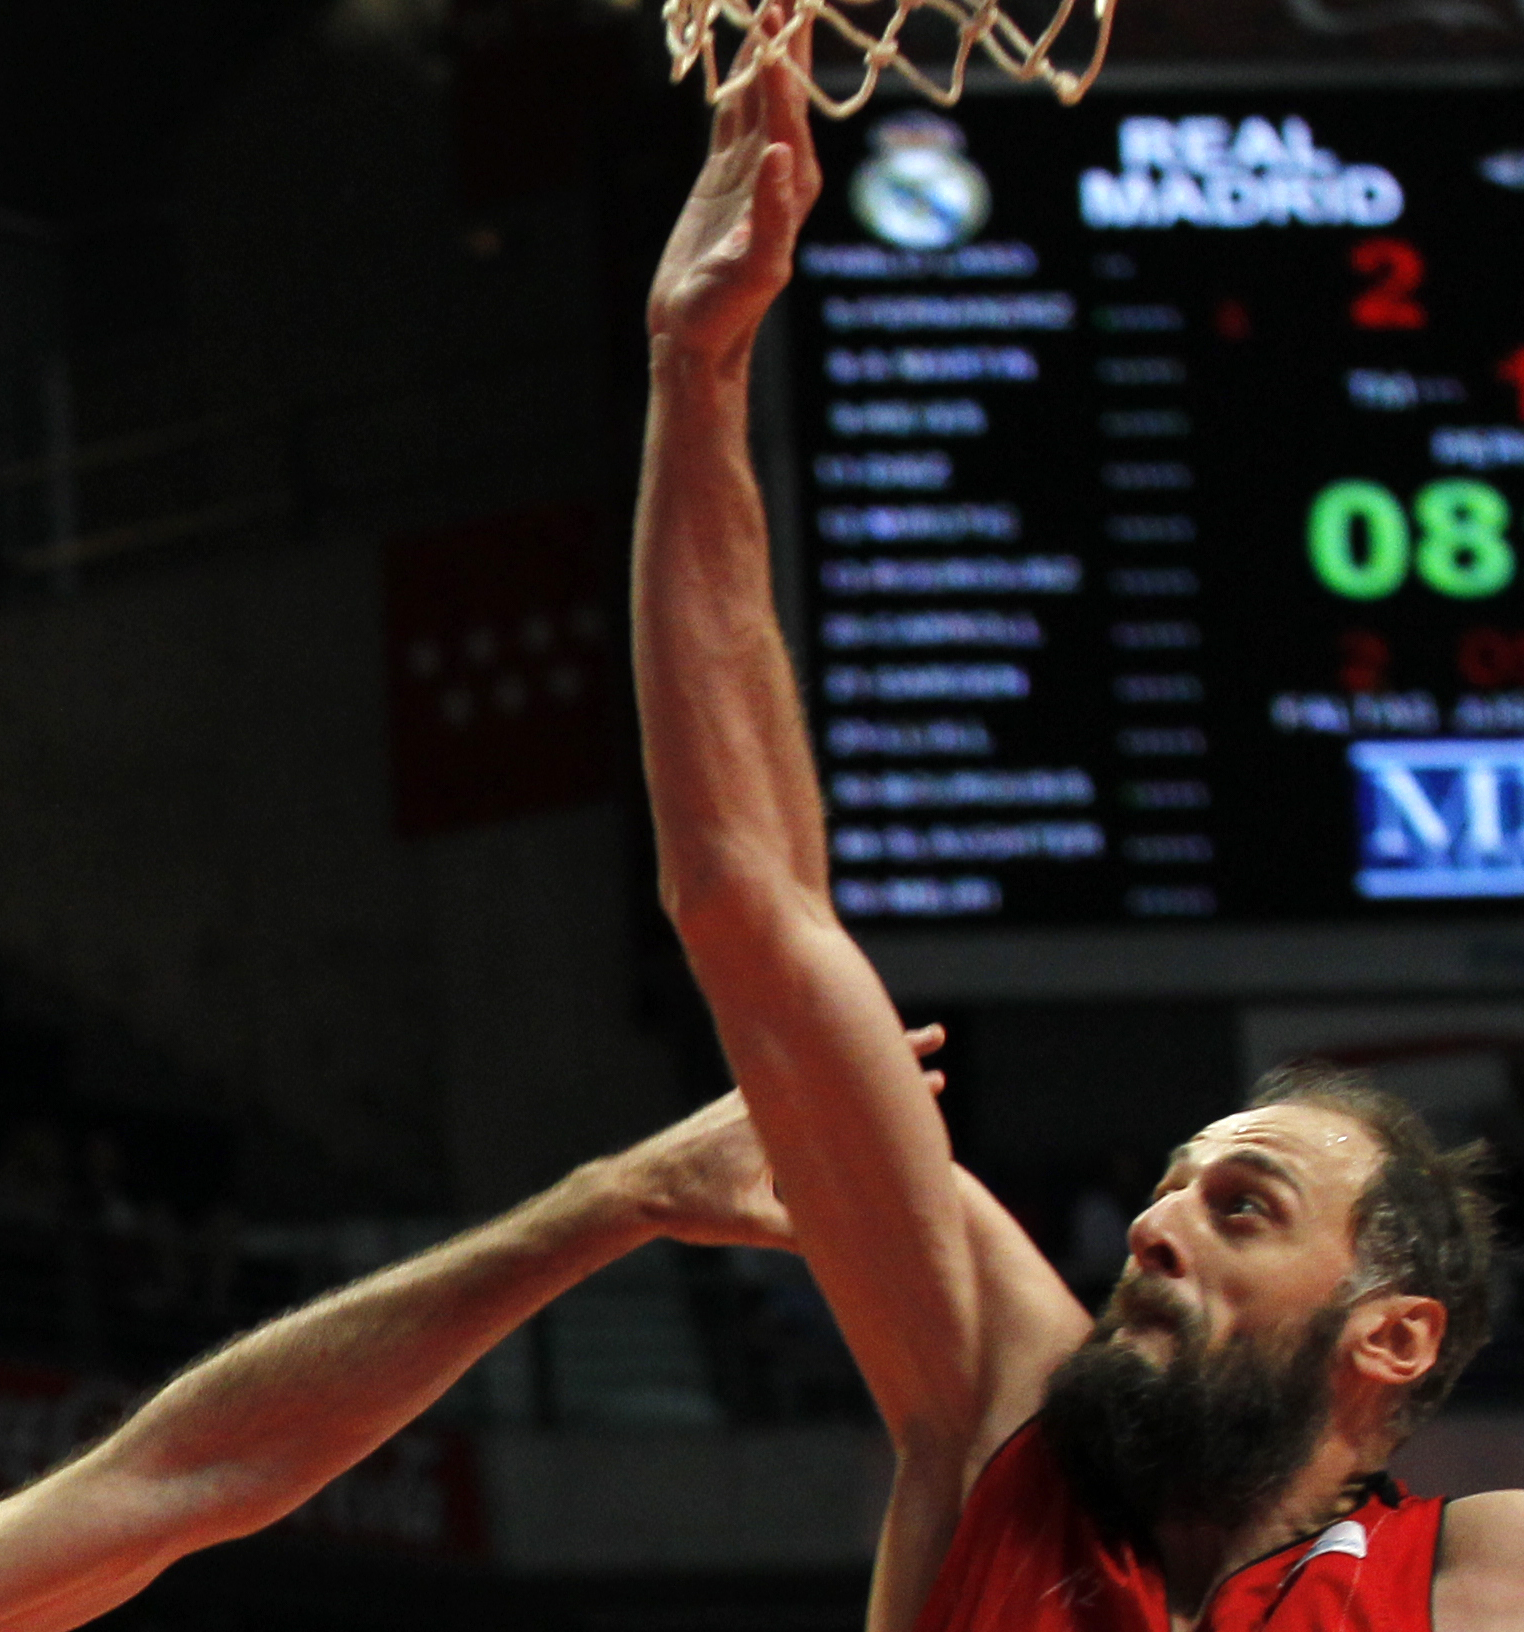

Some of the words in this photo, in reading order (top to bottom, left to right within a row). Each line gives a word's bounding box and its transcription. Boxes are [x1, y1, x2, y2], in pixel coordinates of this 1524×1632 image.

[1118, 113, 1342, 176] REAL
[1078, 164, 1406, 230] MADRID
[1348, 236, 1430, 332] 2
[1304, 475, 1520, 603] 08
